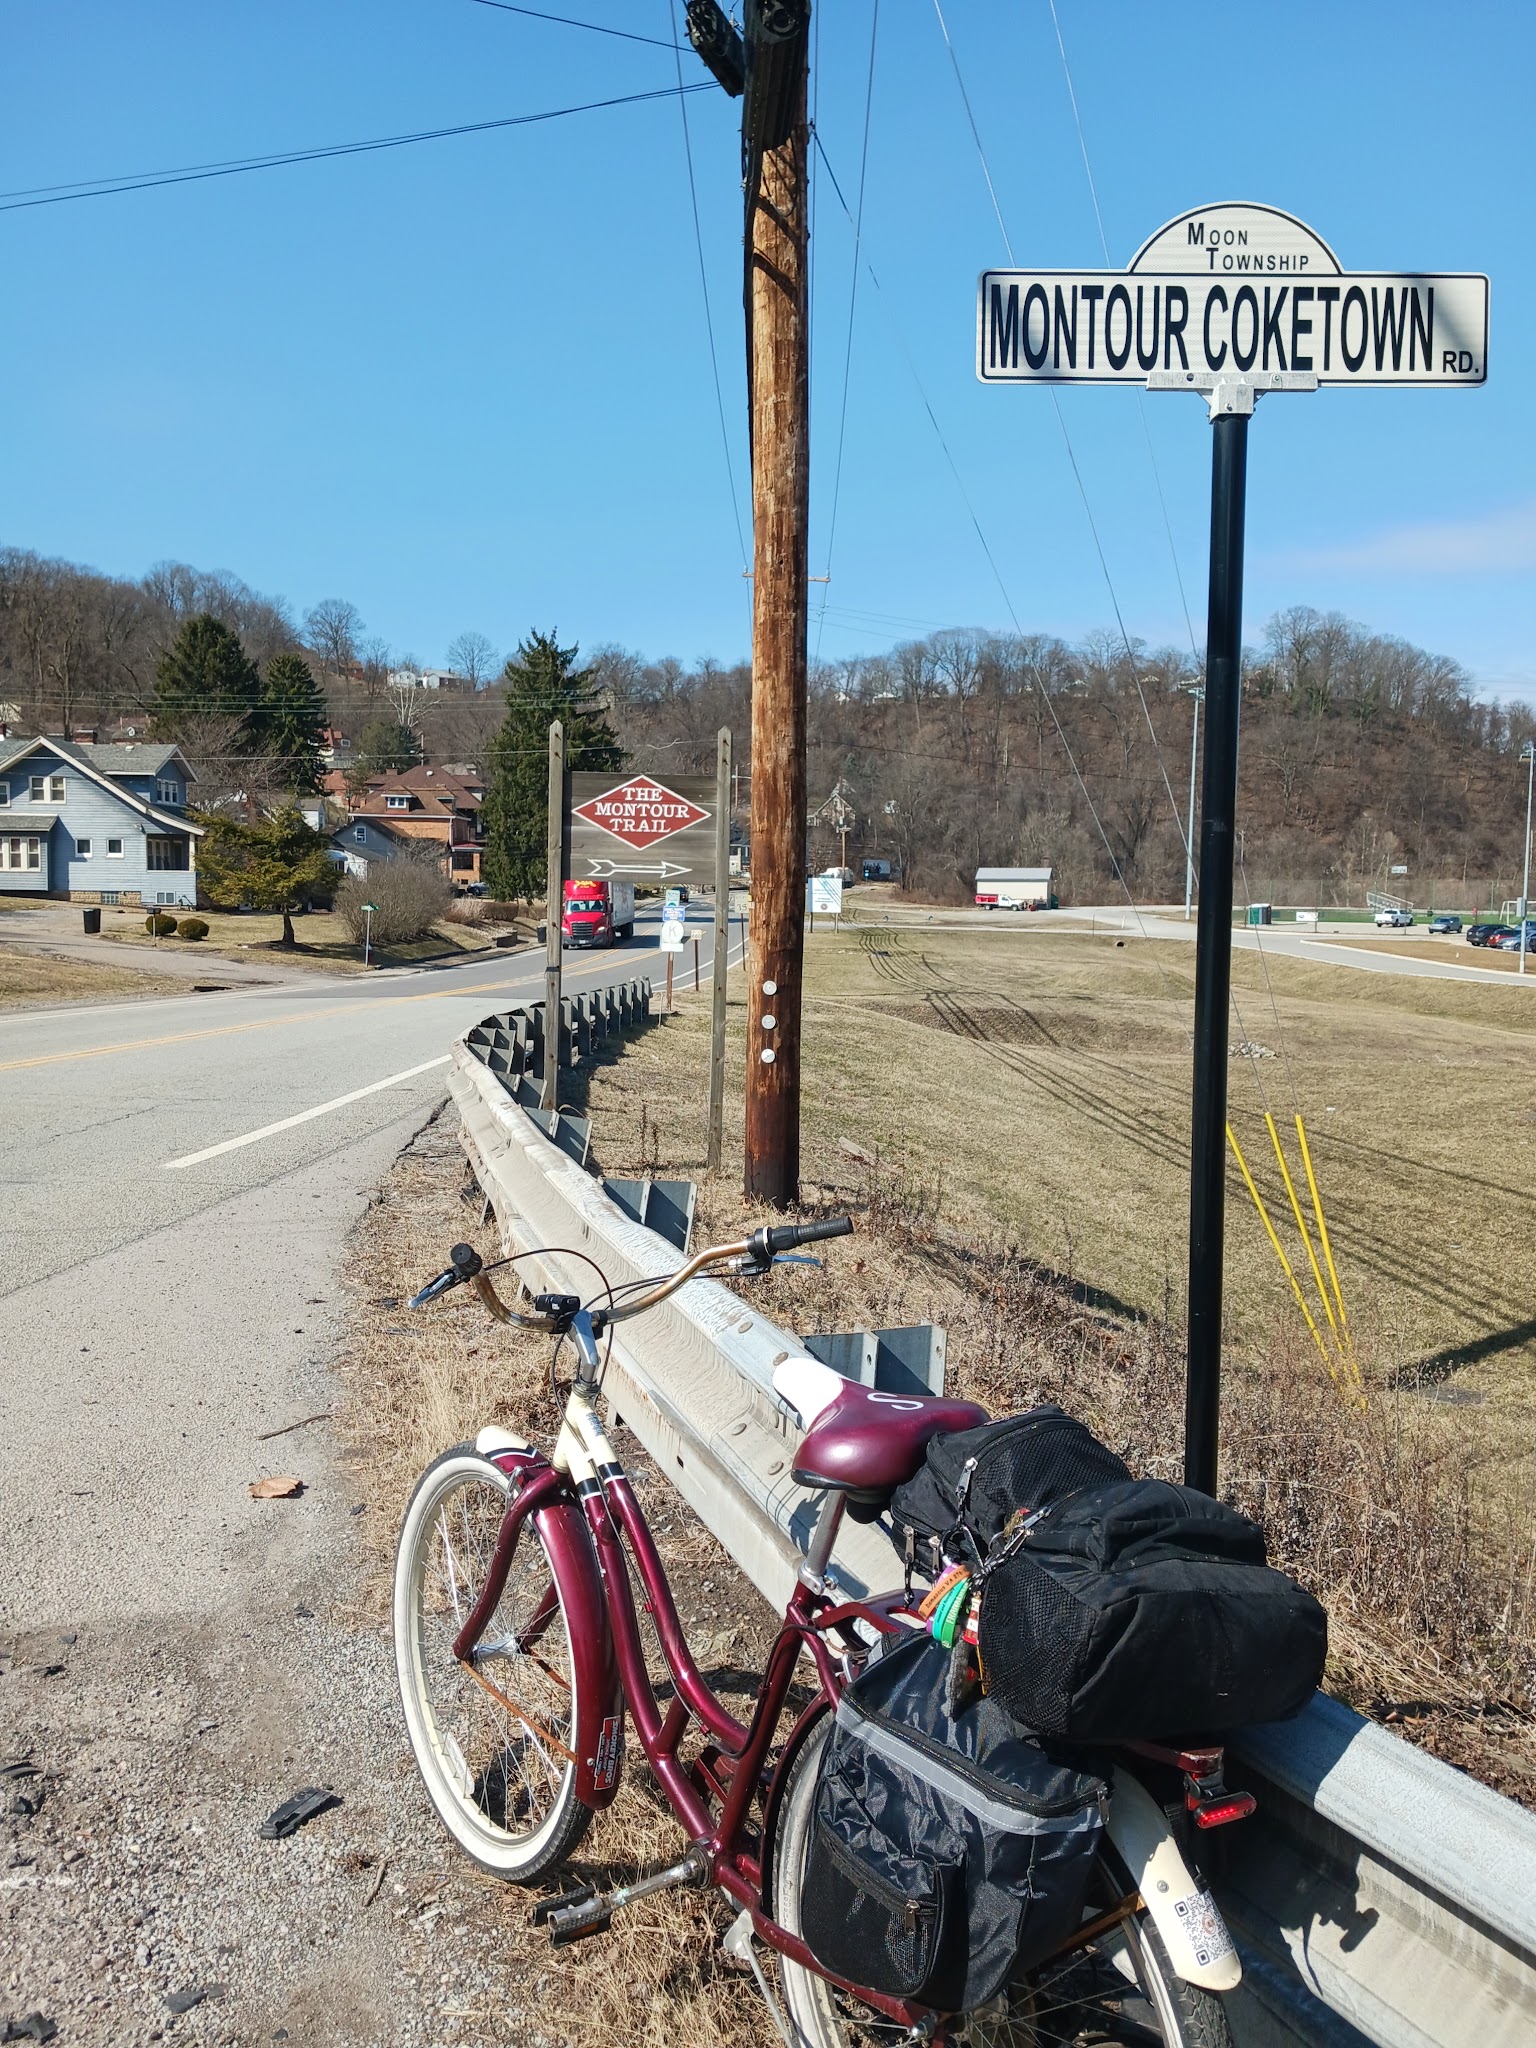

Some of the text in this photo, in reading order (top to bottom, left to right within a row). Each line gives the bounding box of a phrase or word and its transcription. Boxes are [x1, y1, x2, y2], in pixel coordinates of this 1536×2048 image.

[1187, 222, 1248, 246] MOON
[1205, 247, 1309, 271] TOWNSHIP
[989, 282, 1480, 374] MONTOUR COKETOWN RD.
[621, 787, 663, 801] THE
[594, 802, 690, 818] MONTOUR
[609, 818, 672, 833] TRAIL
[605, 1720, 619, 1783] SMOKEY BROS
